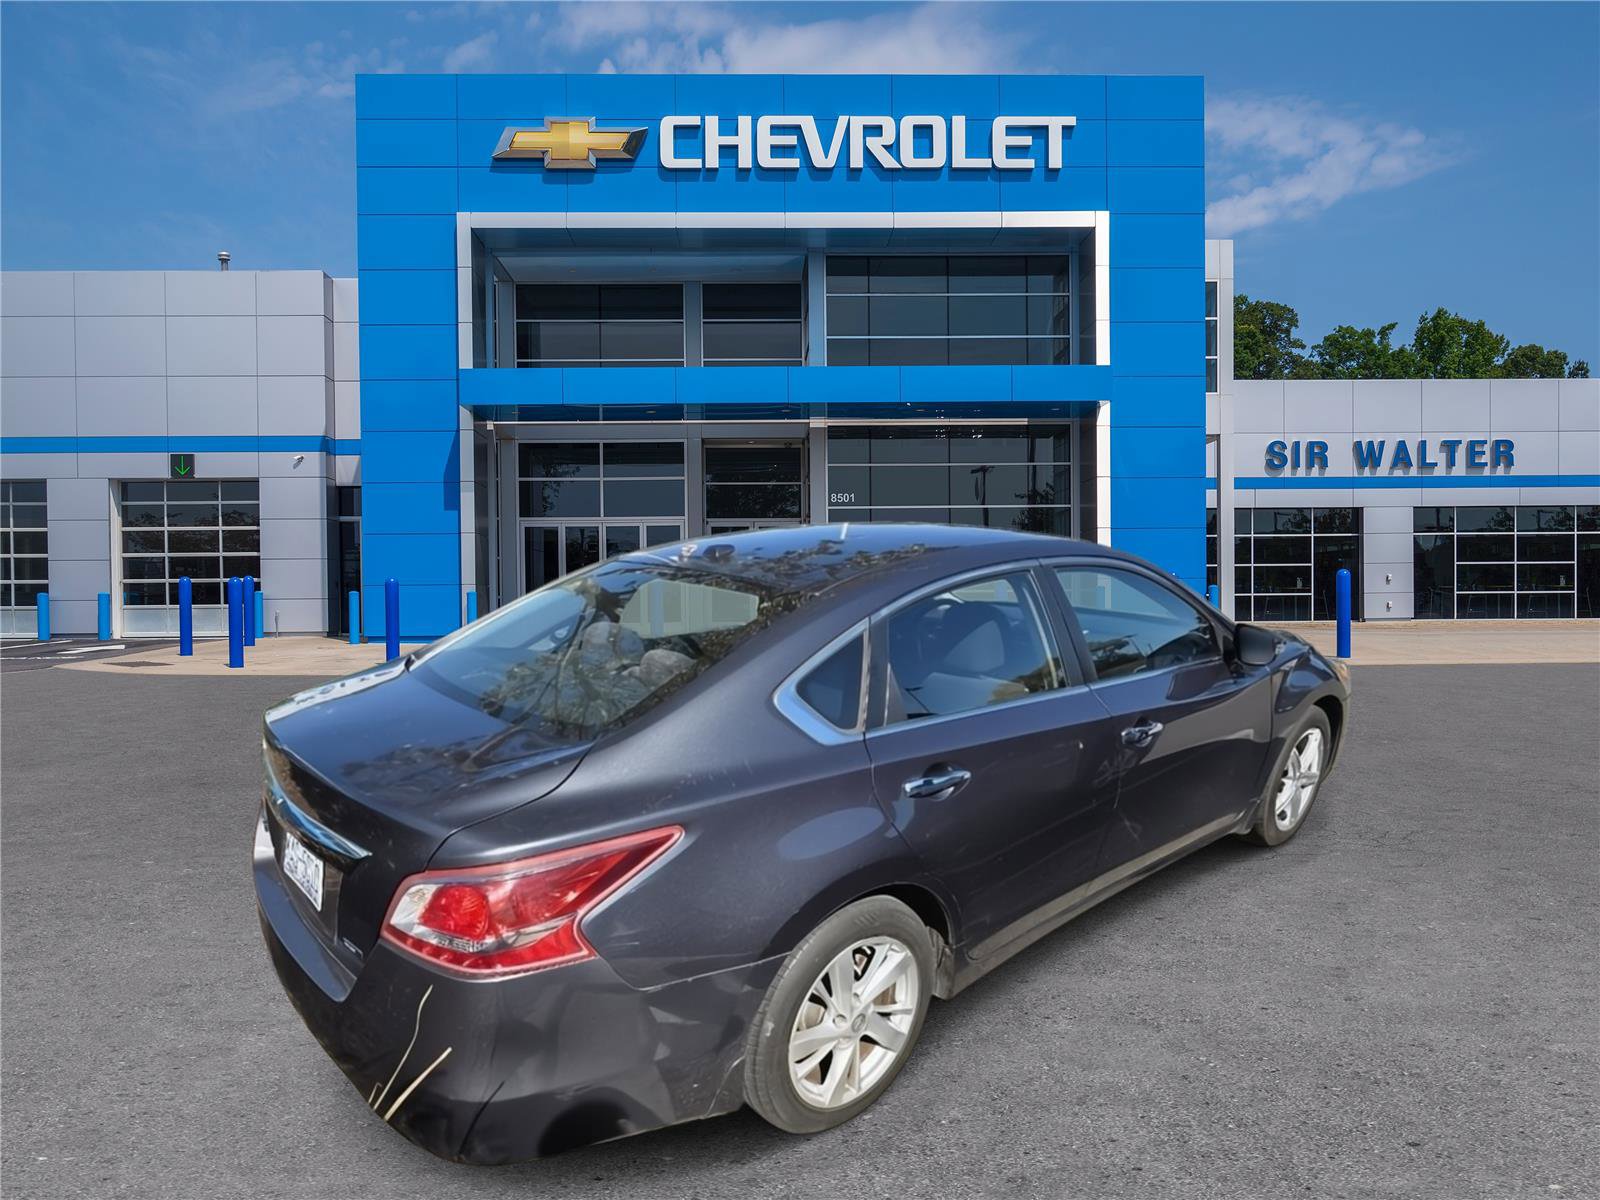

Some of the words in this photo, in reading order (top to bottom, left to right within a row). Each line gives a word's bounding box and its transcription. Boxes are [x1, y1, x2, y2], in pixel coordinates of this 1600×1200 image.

[660, 115, 1077, 170] CHEVROLET
[1265, 439, 1329, 471] SIR
[1353, 439, 1515, 470] WALTER
[830, 493, 855, 503] 8501
